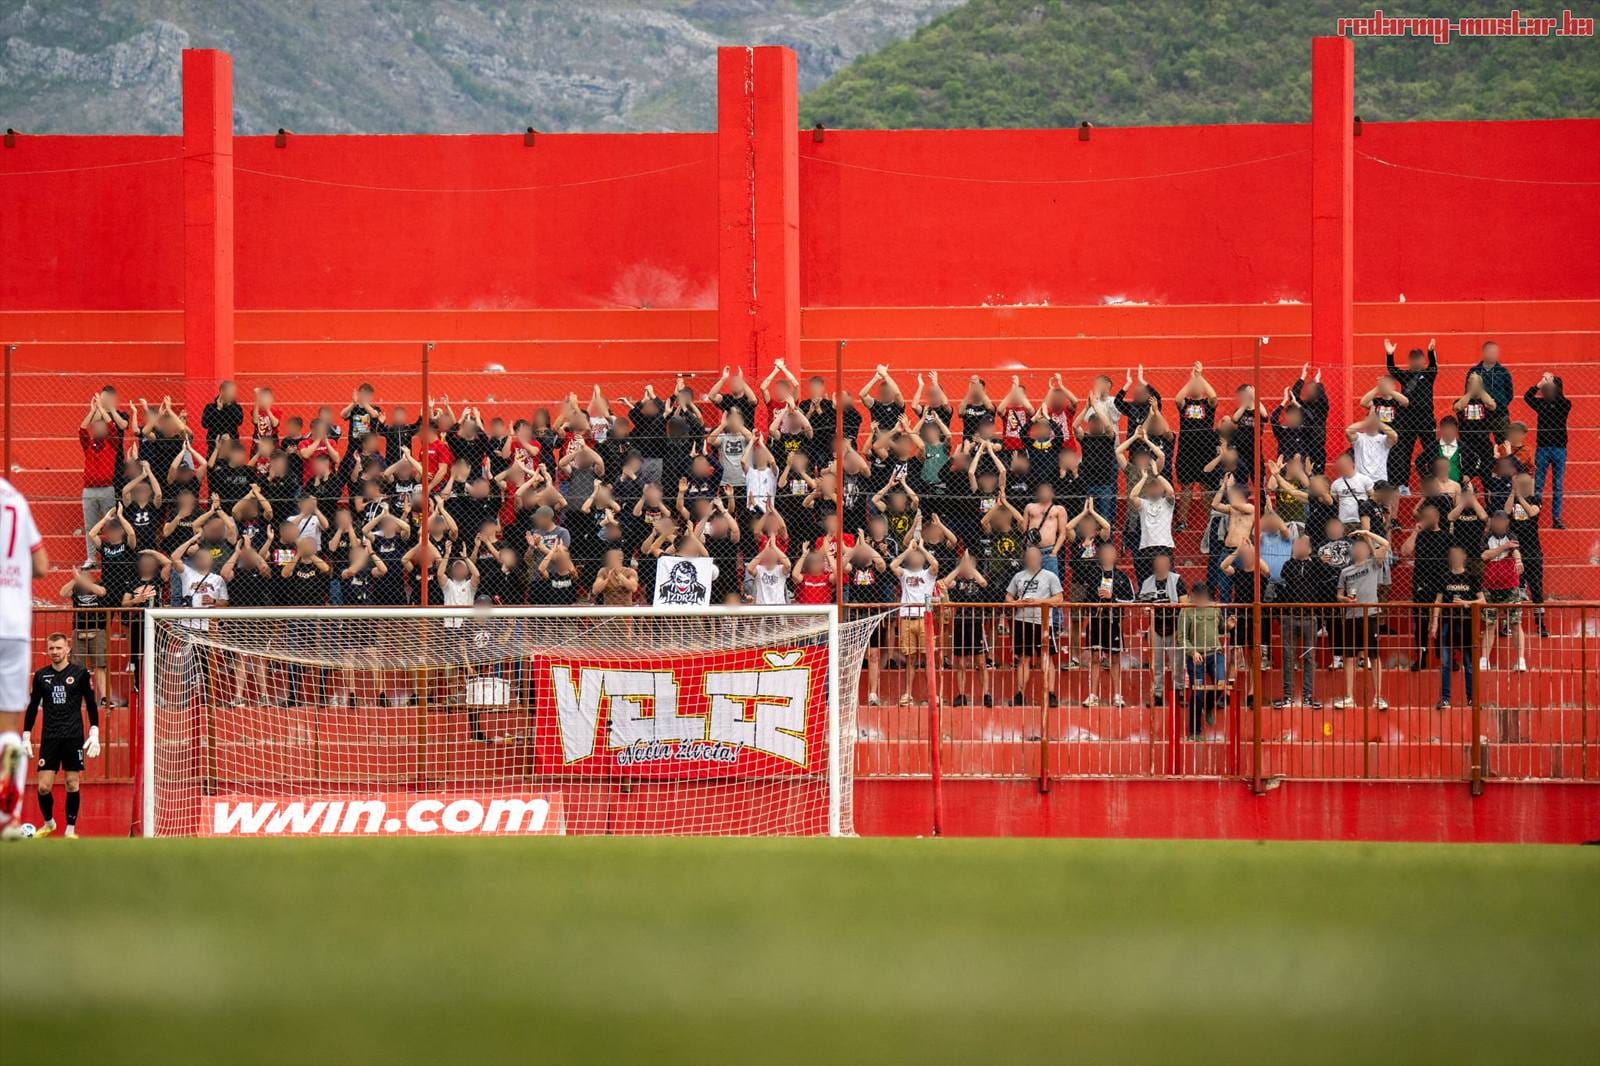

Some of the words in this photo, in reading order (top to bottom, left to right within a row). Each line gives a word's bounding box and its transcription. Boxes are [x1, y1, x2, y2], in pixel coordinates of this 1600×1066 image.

[551, 651, 811, 768] VELEŽ
[617, 736, 672, 765] Način
[212, 798, 550, 834] wwin.com
